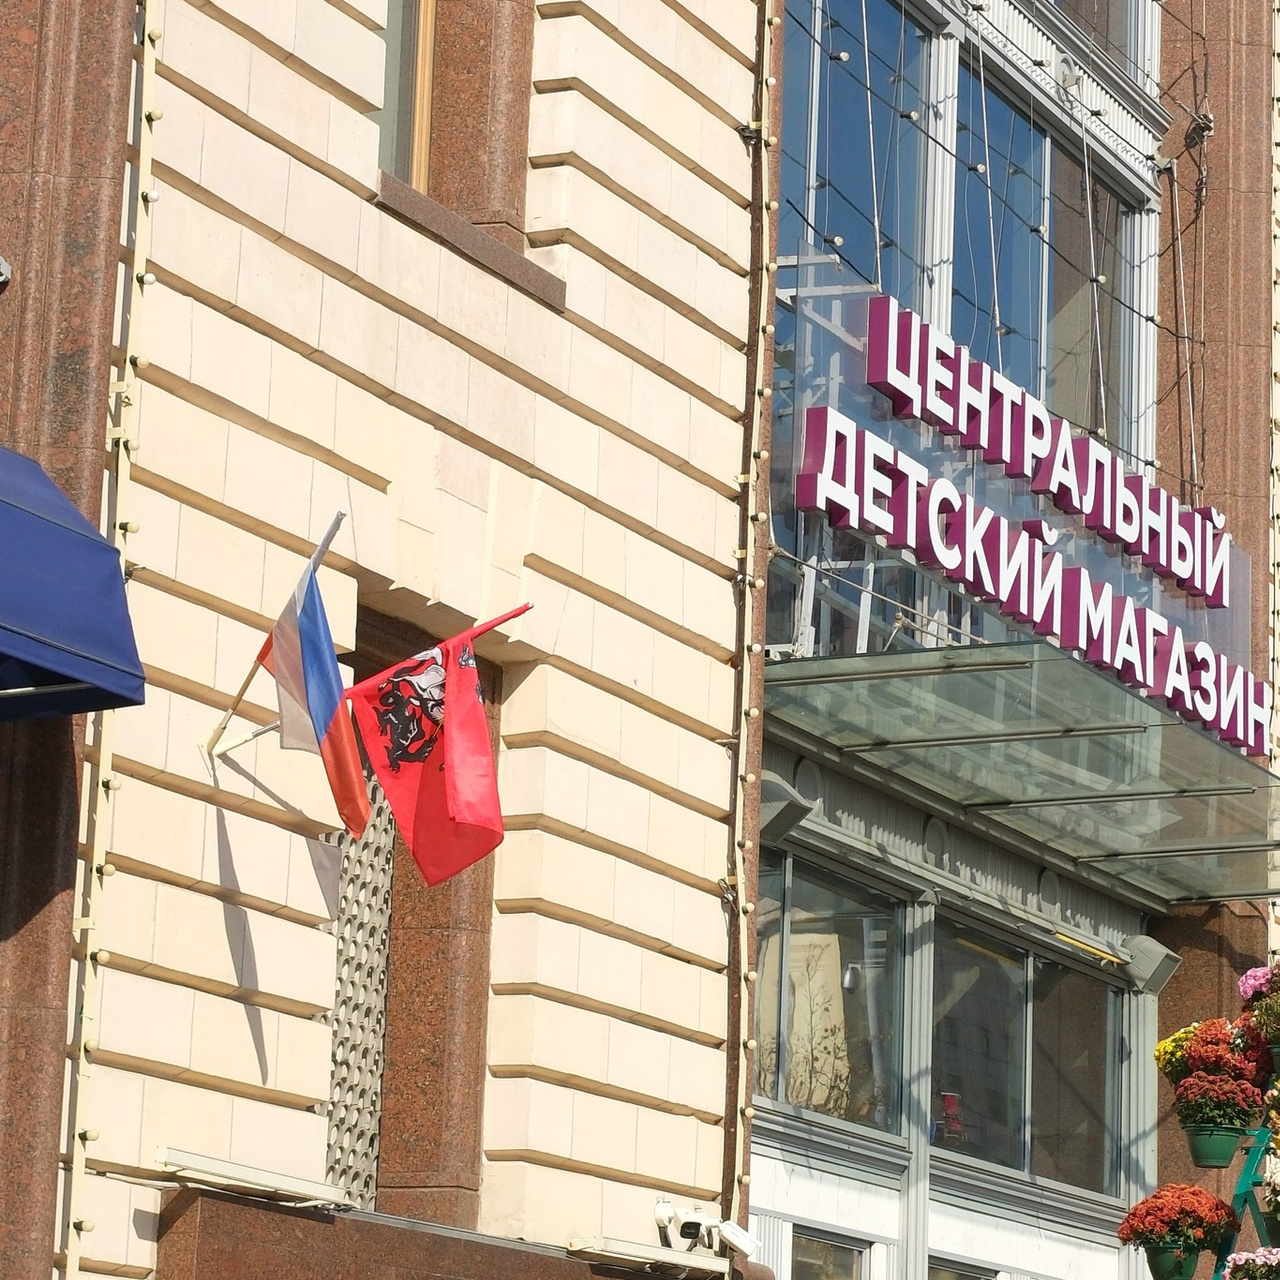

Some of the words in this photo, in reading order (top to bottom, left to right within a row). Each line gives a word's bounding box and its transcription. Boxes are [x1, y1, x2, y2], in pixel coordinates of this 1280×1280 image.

[808, 407, 1063, 637] ДЕТСКИЙ
[1075, 567, 1271, 755] МАГАЗИН
[880, 296, 1231, 609] ЦЕНТРАЛЬНЫЙ
